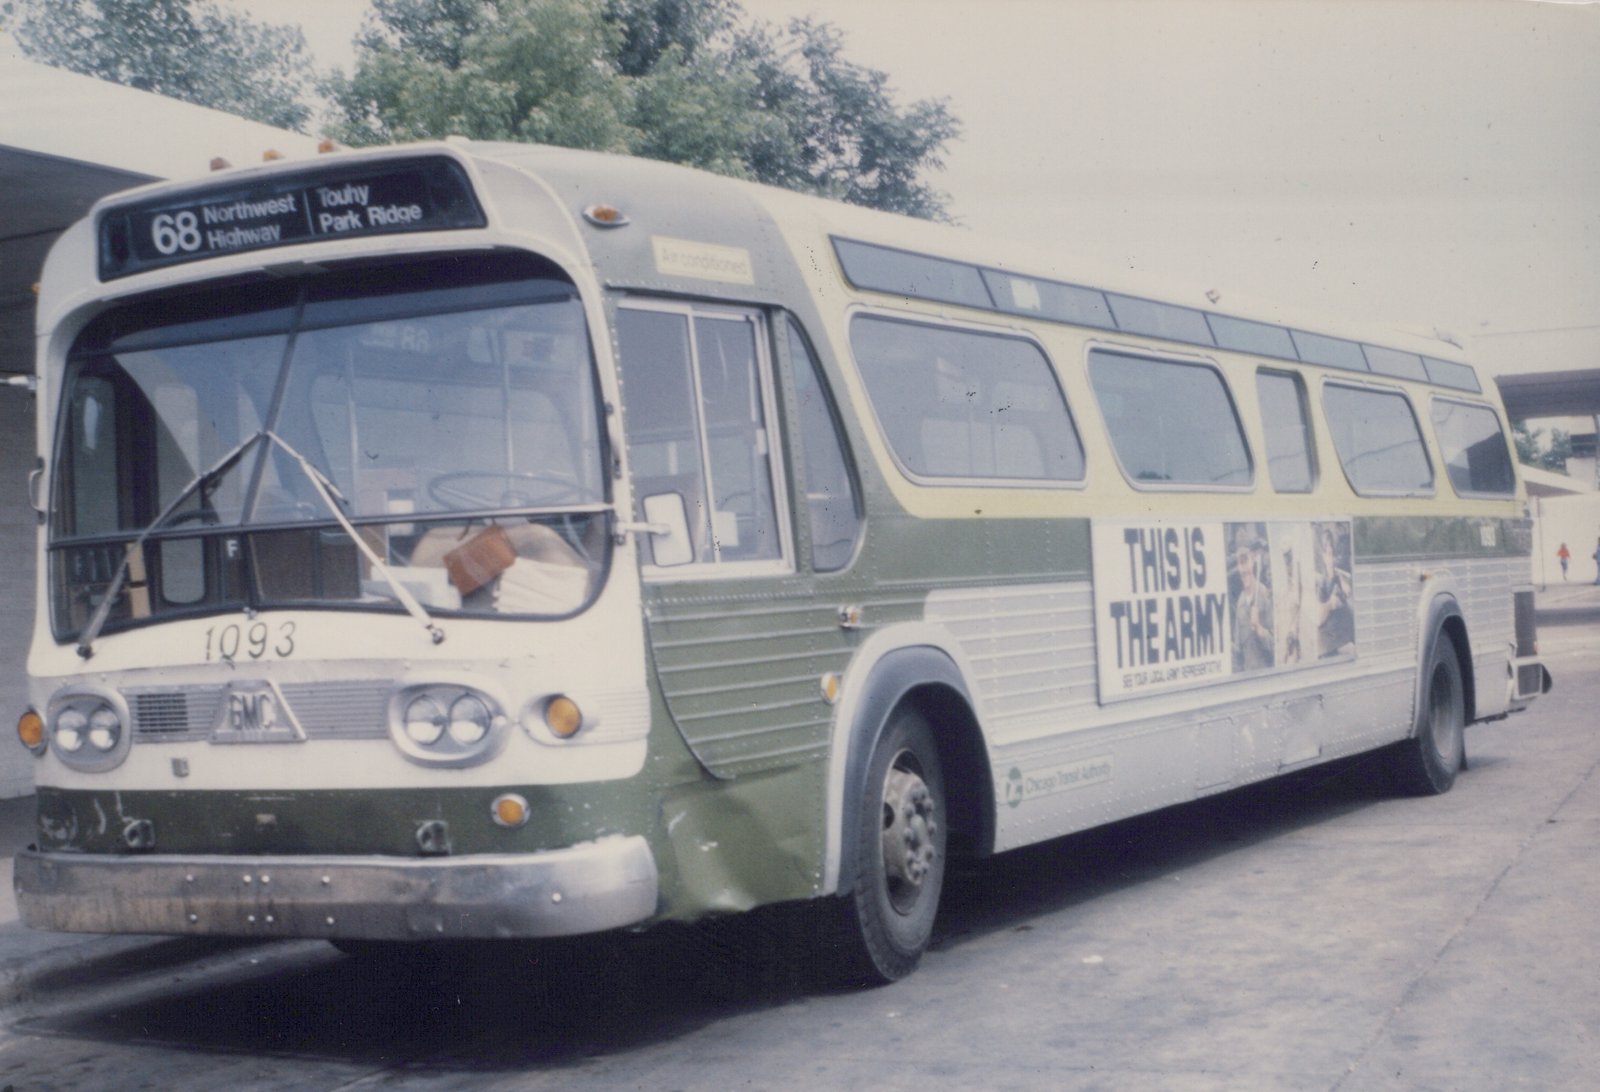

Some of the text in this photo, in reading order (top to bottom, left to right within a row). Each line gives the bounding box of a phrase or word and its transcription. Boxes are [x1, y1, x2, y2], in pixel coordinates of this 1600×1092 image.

[203, 194, 297, 225] Northwest
[316, 183, 369, 208] Touhy
[152, 211, 202, 255] 68
[319, 204, 423, 233] Park Ridge
[206, 224, 281, 250] Highway
[227, 540, 238, 557] F
[1123, 526, 1208, 594] THIS IS
[204, 620, 296, 662] 1093
[1109, 593, 1227, 669] THE ARMY
[229, 692, 276, 732] GMC
